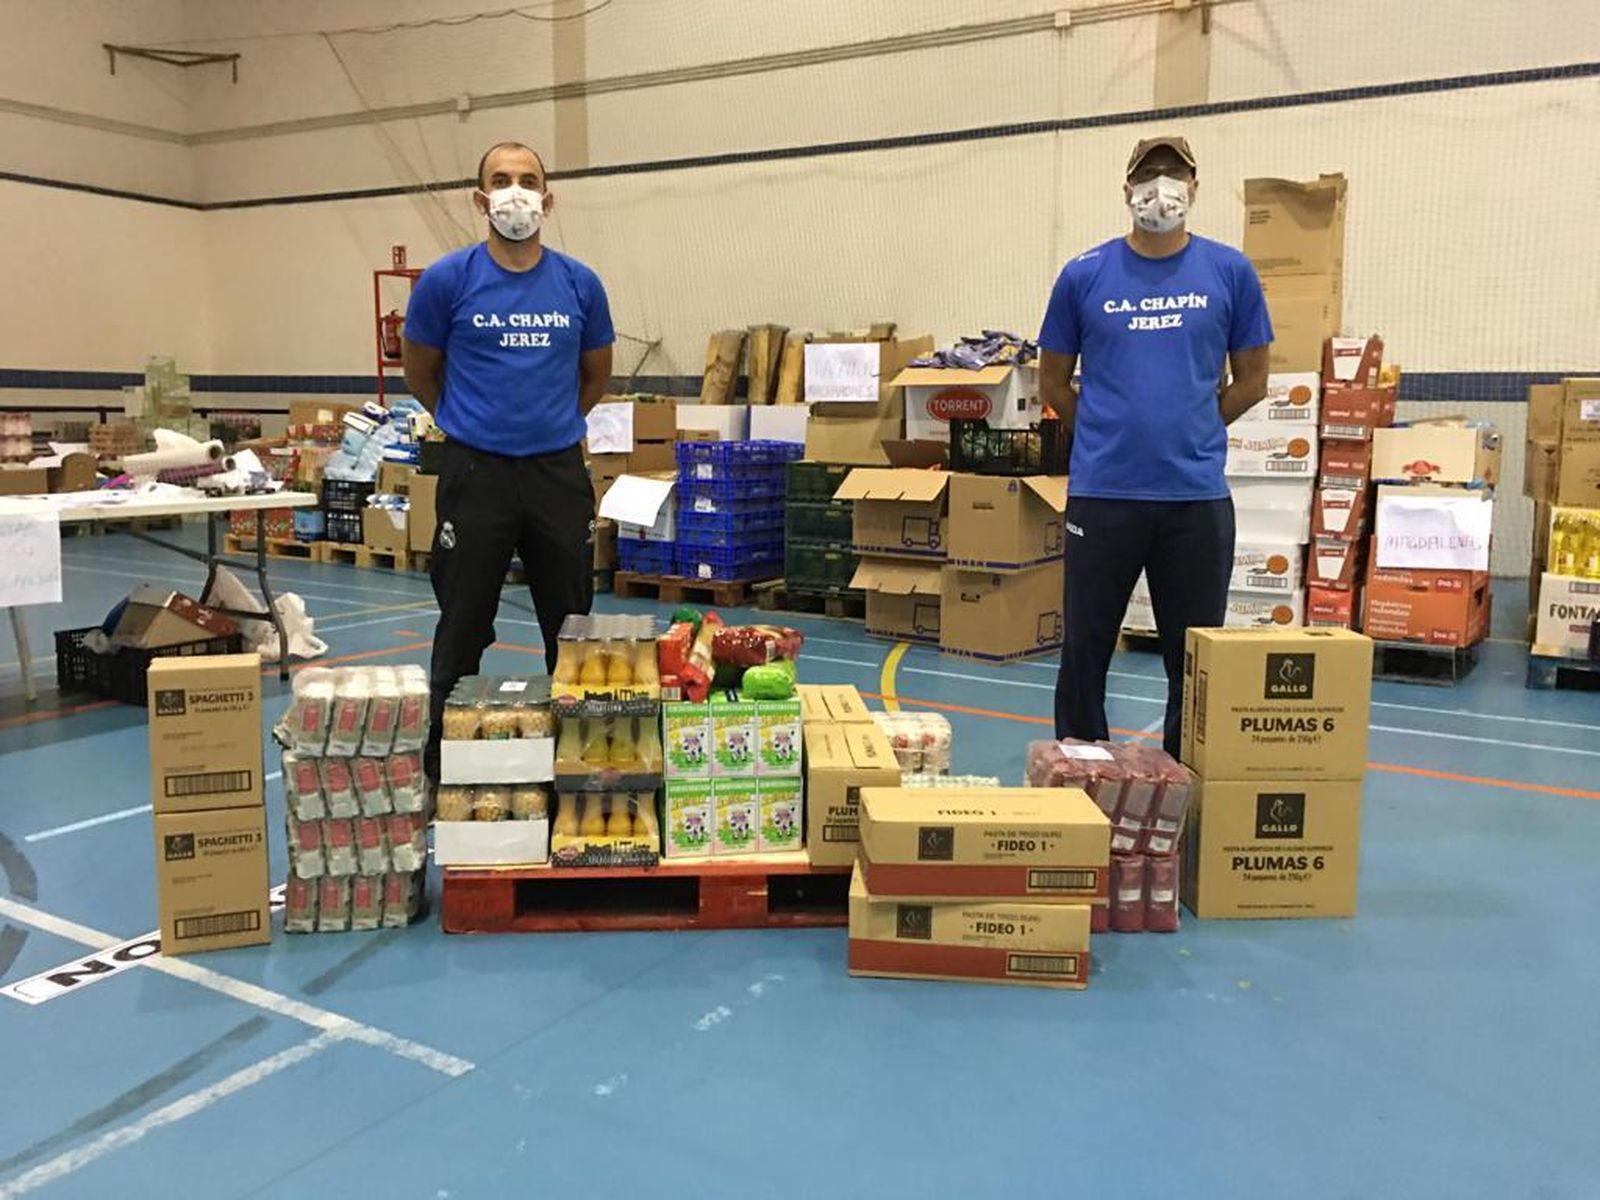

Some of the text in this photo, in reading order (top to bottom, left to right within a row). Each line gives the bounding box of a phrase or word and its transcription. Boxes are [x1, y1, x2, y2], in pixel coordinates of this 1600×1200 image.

[1103, 292, 1208, 313] C.A. CHAPÍN
[473, 310, 570, 328] C.A. CHAPÍN
[1128, 314, 1183, 331] JEREZ
[500, 333, 551, 347] JEREZ
[933, 399, 987, 412] TORRENT
[1549, 603, 1600, 620] FONTA
[1271, 684, 1308, 693] GALLO
[188, 692, 245, 705] SPAGHETTI
[1240, 717, 1335, 732] PLUMAS 6
[828, 806, 859, 816] PLUM
[1262, 824, 1298, 832] GALLO
[197, 834, 253, 849] SPAGHETTI
[997, 840, 1047, 851] FIDEO 1
[1232, 856, 1325, 871] PLUMAS 6
[975, 922, 1025, 936] FIDEO 1
